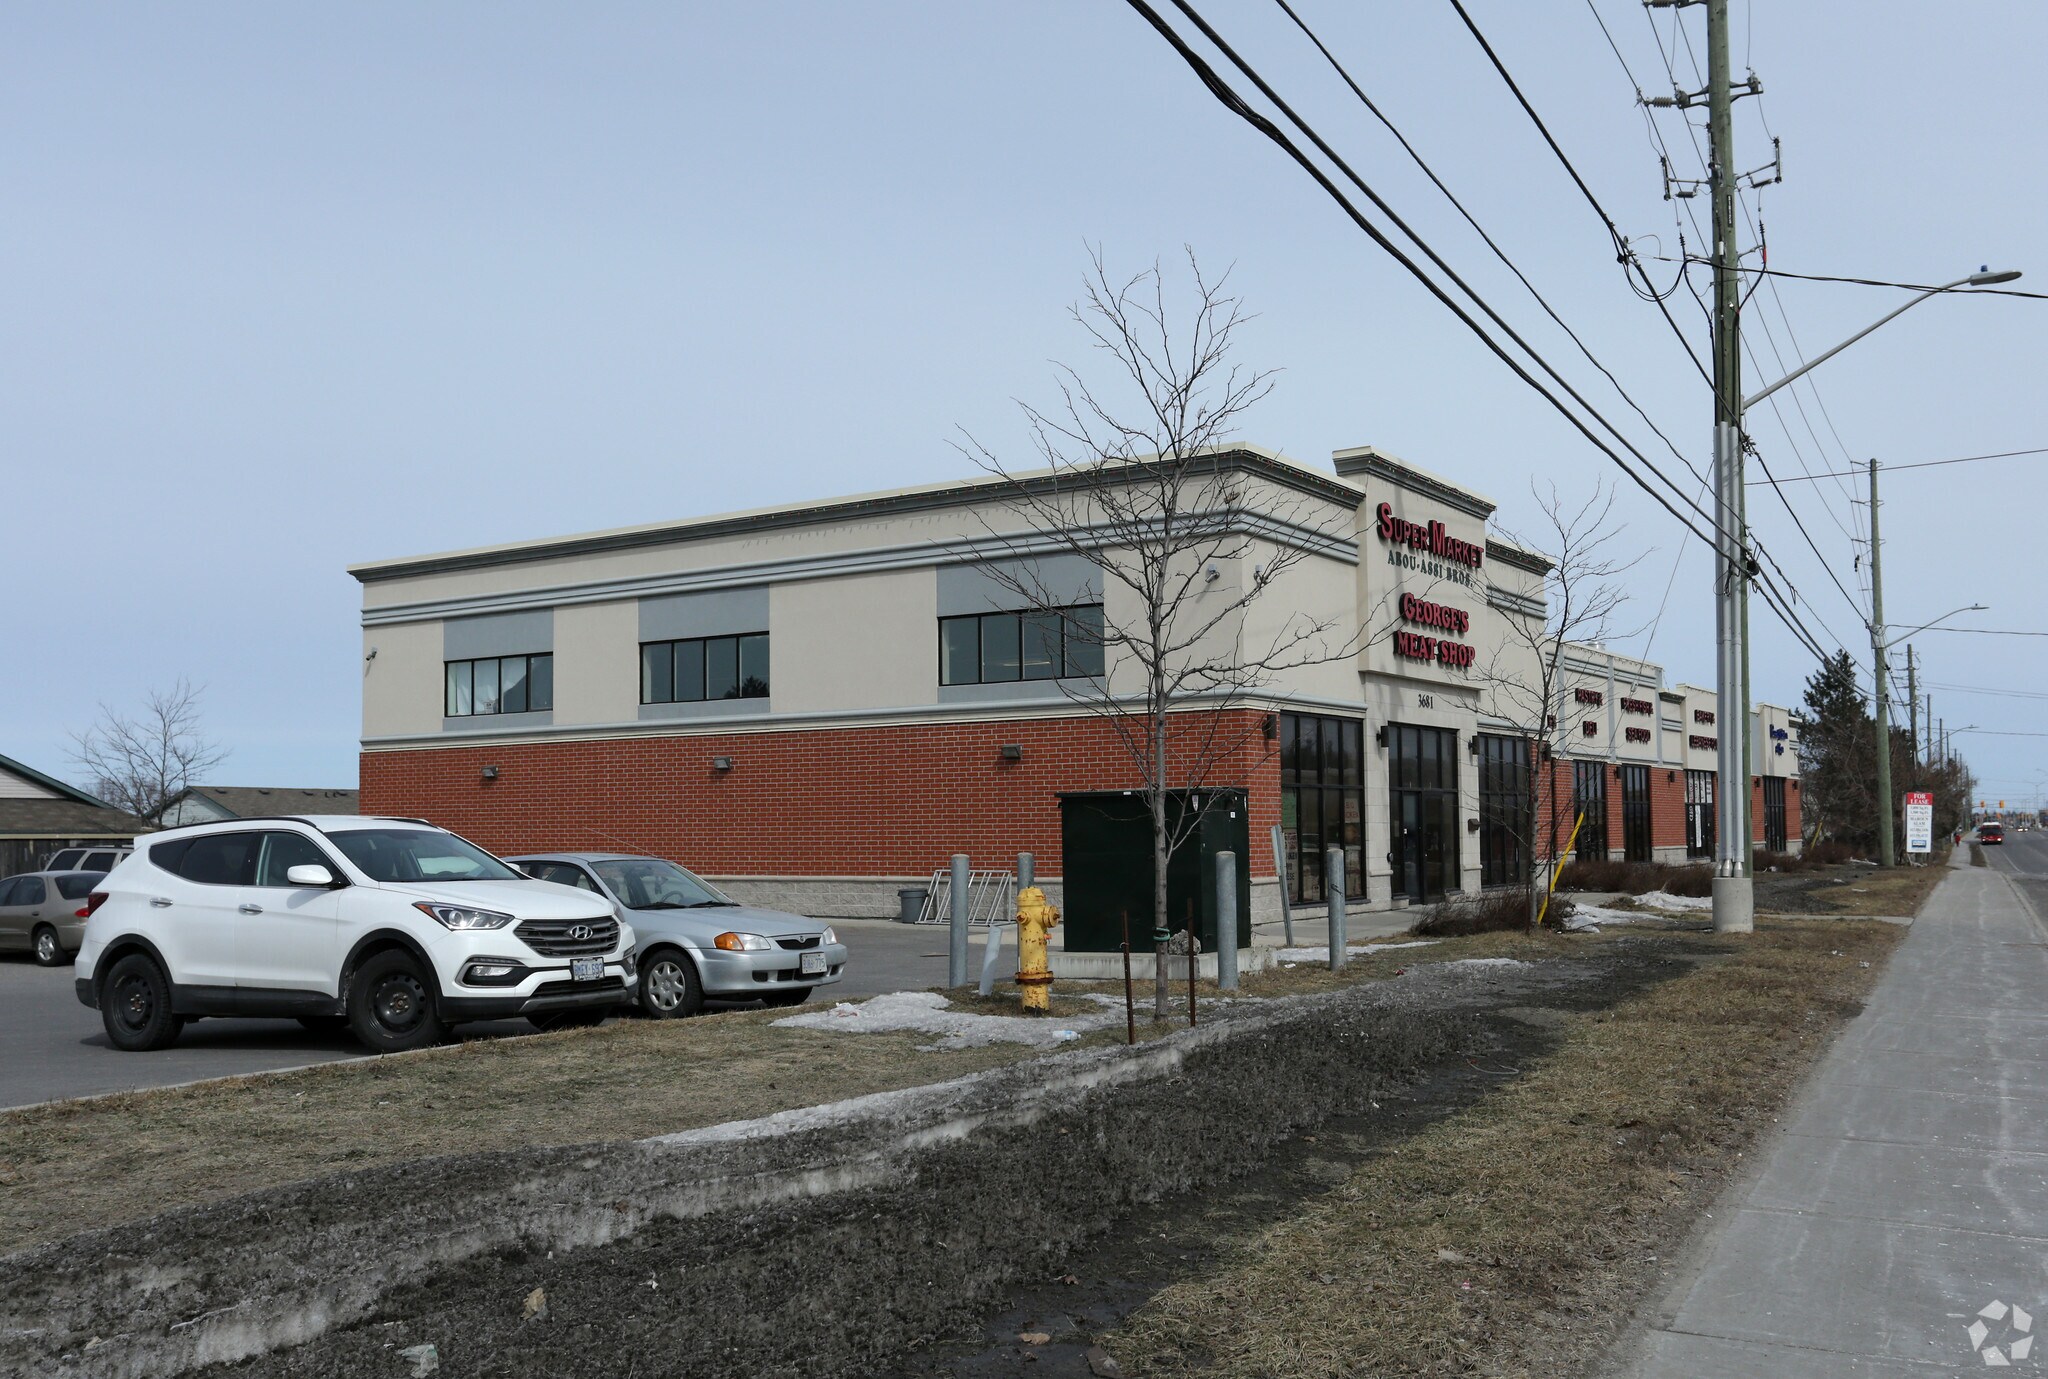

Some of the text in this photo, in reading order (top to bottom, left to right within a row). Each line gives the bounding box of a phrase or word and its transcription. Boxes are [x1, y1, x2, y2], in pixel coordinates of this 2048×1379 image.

[1377, 502, 1485, 568] SUPER MARKET
[1400, 592, 1470, 633] GEORGE'S
[1394, 630, 1476, 668] MEAT SHOP
[1418, 694, 1434, 709] 3681
[1583, 721, 1597, 736] DELI
[1626, 727, 1651, 743] SEAFOOD
